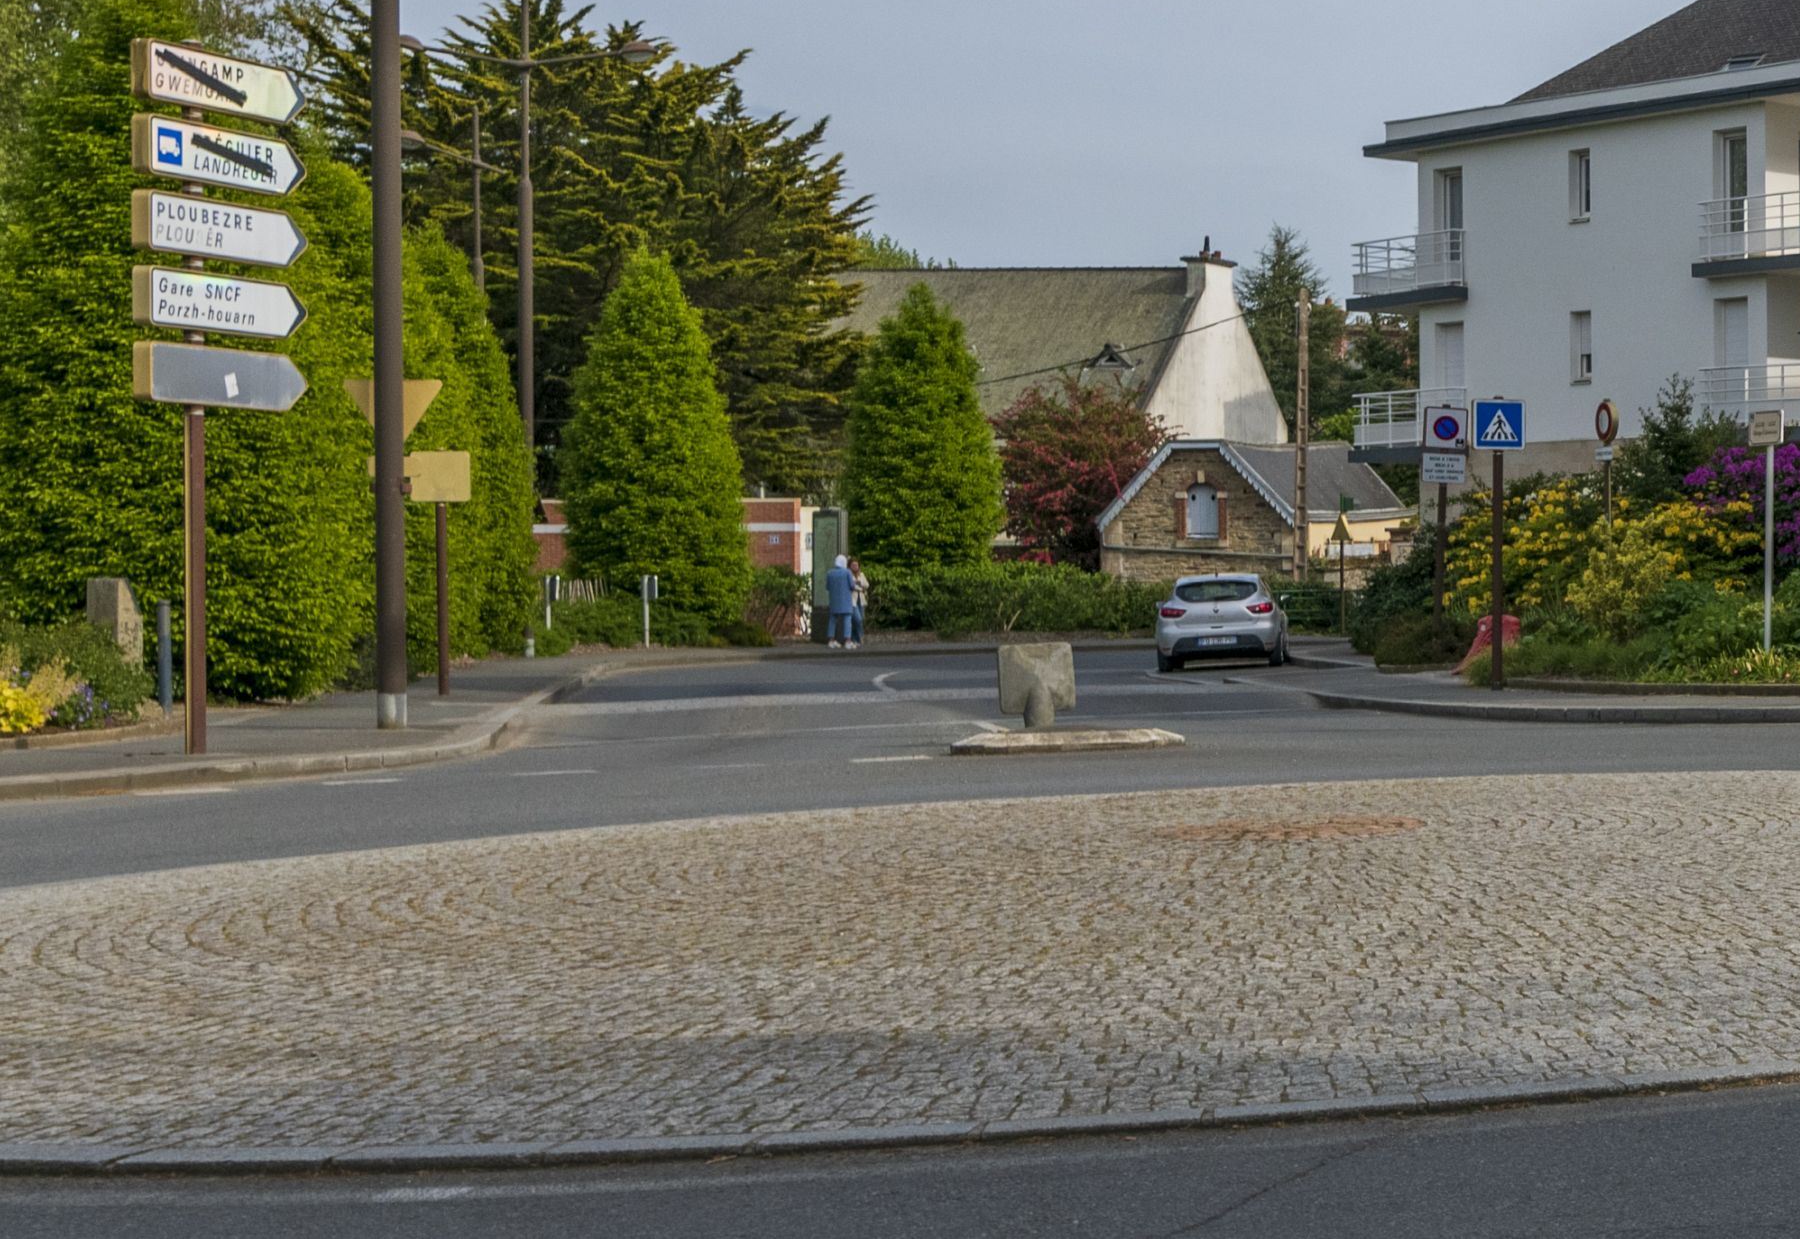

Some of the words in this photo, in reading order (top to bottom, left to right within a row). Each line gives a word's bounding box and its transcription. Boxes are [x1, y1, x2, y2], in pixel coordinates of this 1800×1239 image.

[193, 133, 273, 163] ÉGUIER
[157, 201, 253, 232] PLOUBEZRE
[159, 277, 193, 297] Gare
[205, 283, 242, 303] SNCF
[158, 299, 255, 326] Porzh-houarn
